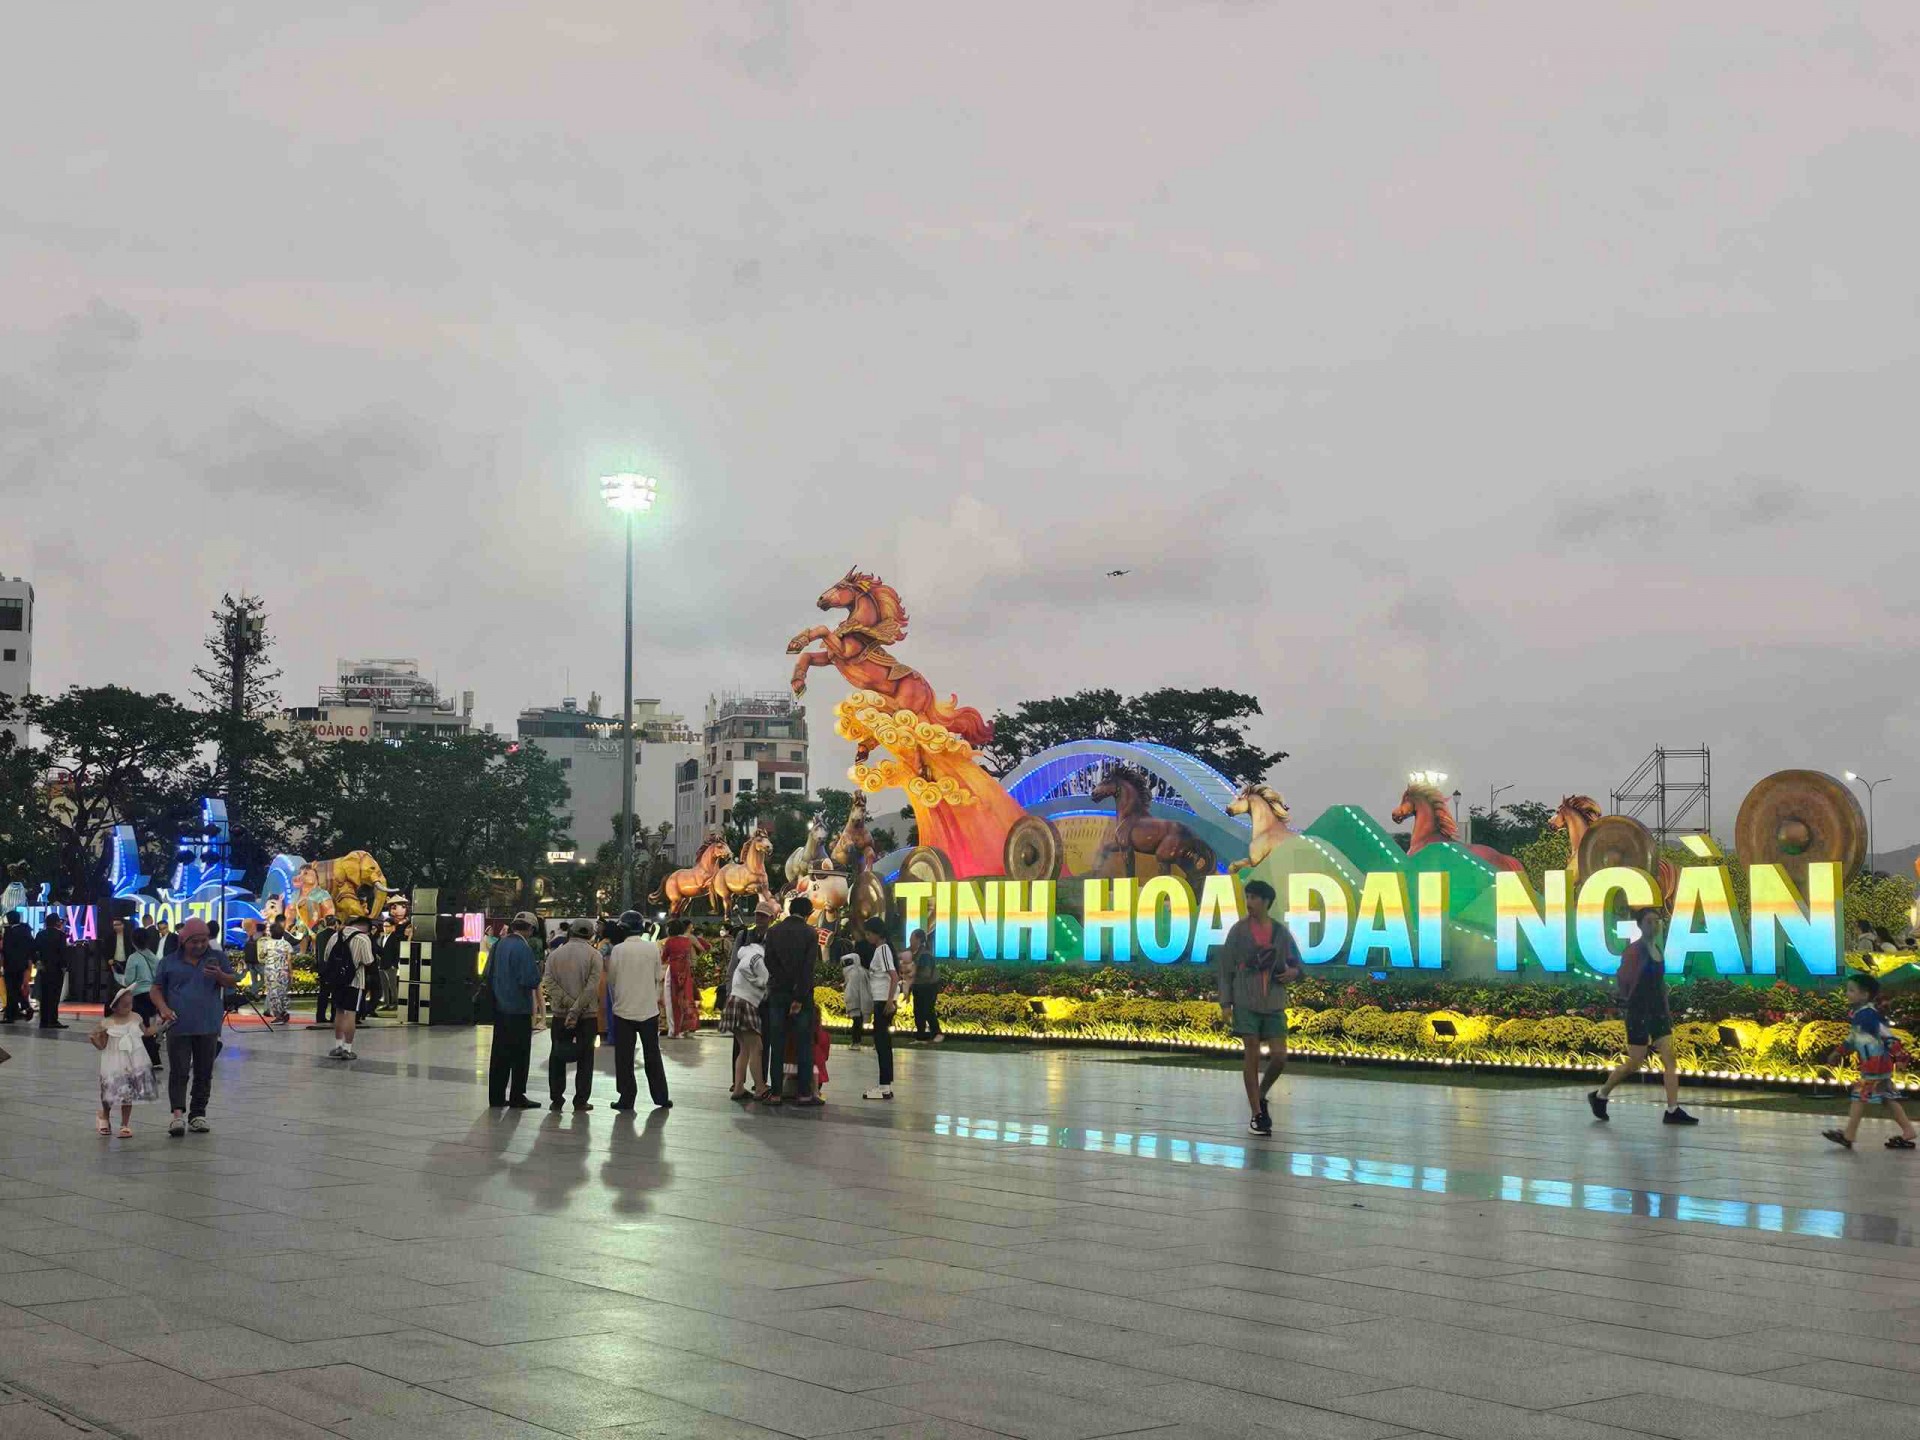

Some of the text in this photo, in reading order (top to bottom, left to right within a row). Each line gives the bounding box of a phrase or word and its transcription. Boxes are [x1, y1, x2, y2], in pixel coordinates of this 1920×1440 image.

[341, 675, 374, 685] HOTEL
[894, 879, 1053, 961] TINH
[1083, 875, 1246, 963] HOA
[1496, 835, 1842, 976] NGÀN
